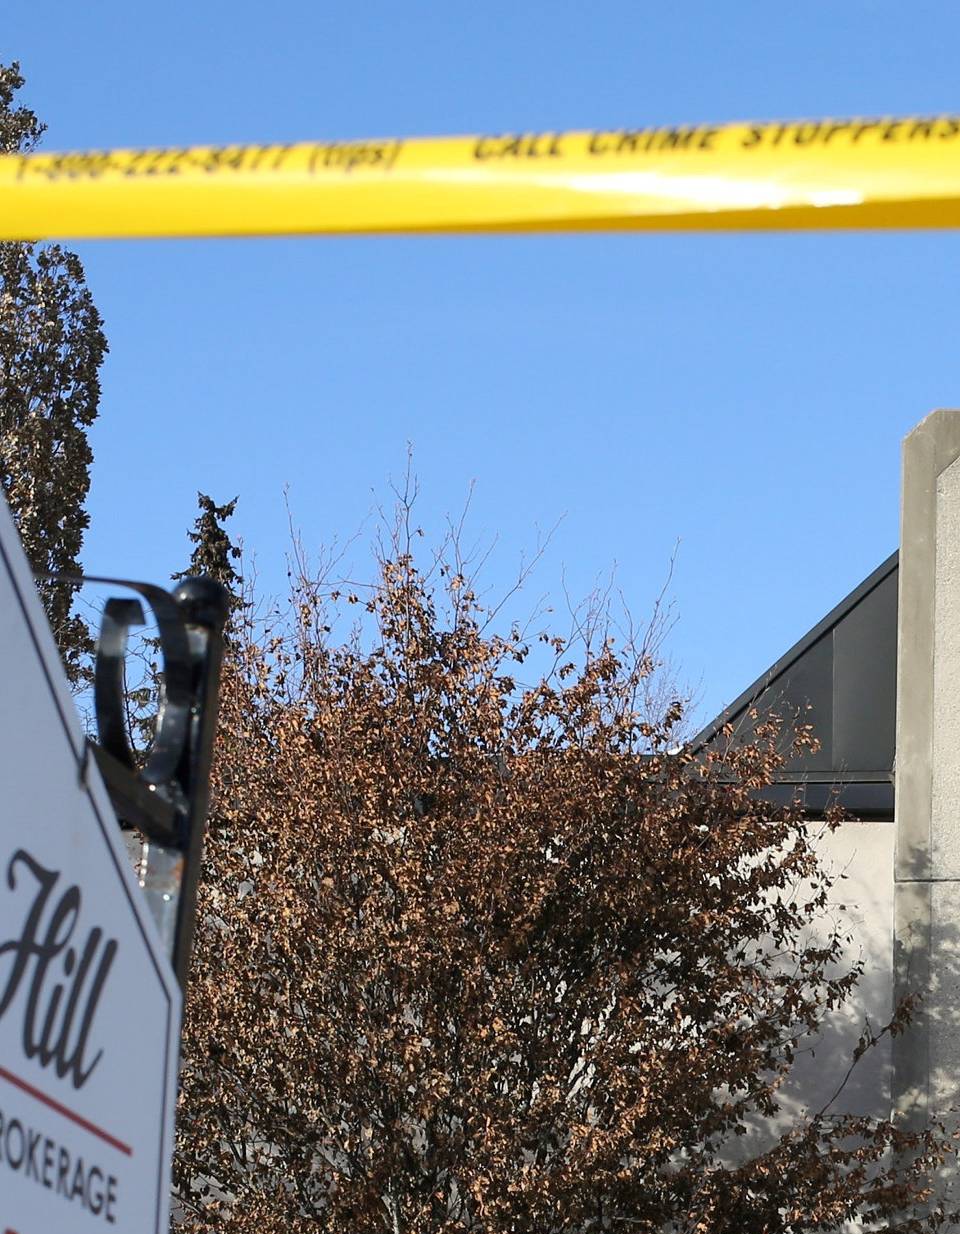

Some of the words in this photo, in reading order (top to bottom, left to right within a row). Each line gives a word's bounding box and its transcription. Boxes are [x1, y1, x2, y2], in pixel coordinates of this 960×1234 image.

[473, 131, 563, 160] CALL
[588, 124, 719, 155] CRIME
[0, 848, 118, 1090] Hill
[0, 1111, 118, 1224] OKERAGE
